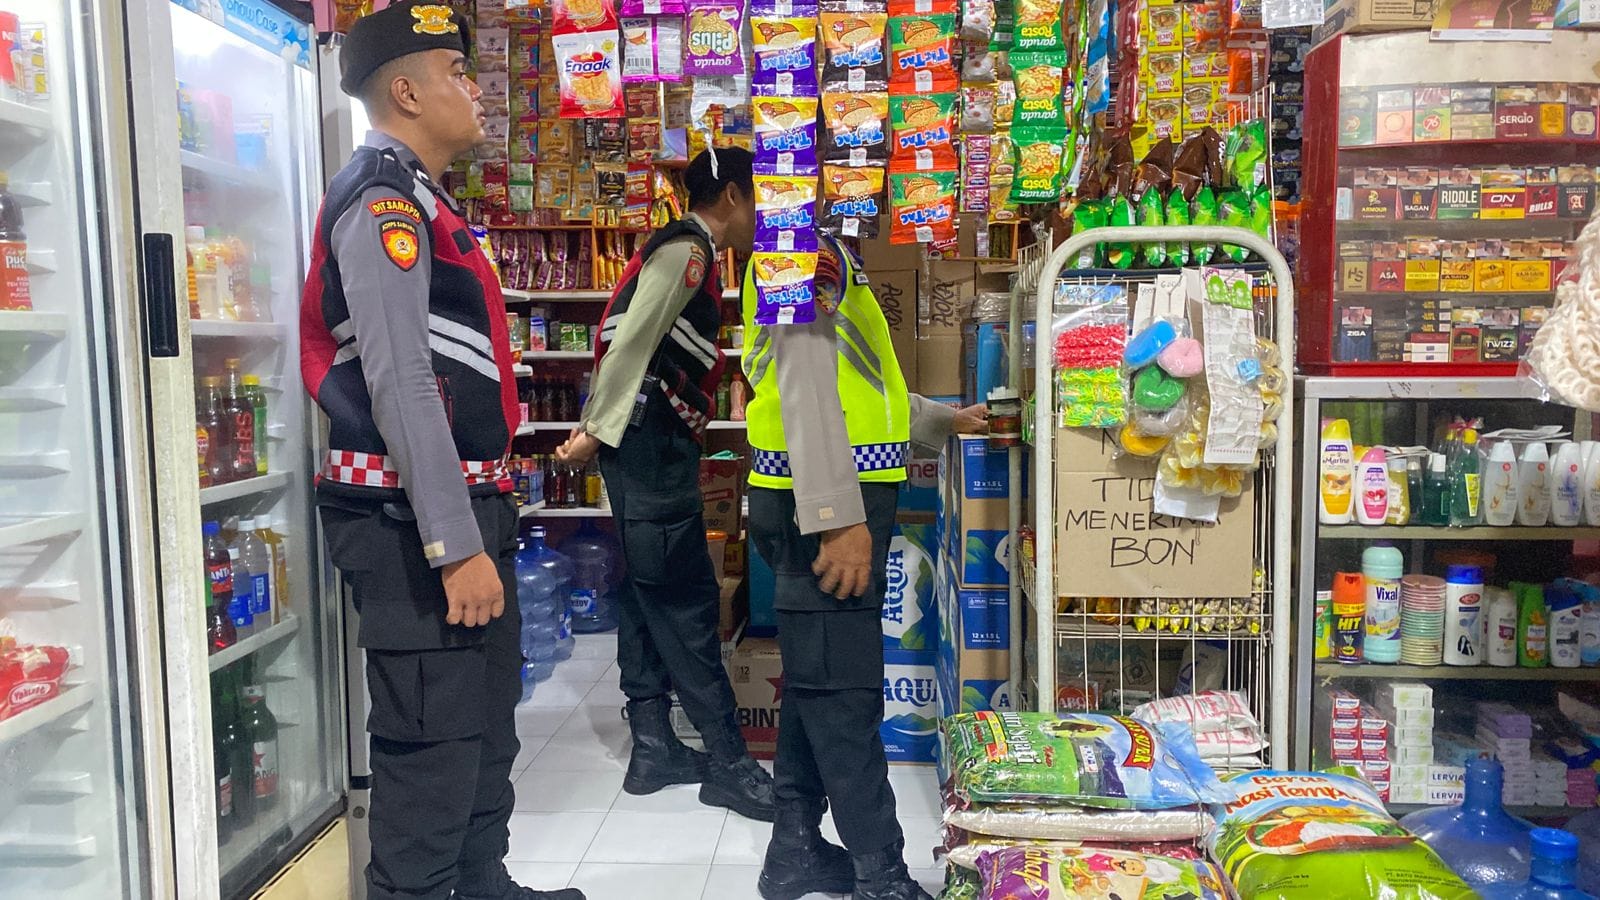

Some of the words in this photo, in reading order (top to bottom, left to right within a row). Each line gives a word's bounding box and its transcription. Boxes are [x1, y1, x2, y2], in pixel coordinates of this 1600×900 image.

[255, 8, 279, 34] Case
[1021, 25, 1055, 37] Rosta
[691, 31, 733, 53] Pilus
[1020, 36, 1056, 48] garuda
[565, 58, 611, 72] Enaak
[694, 56, 732, 69] garuda
[1022, 99, 1056, 111] Rosta
[1020, 109, 1058, 121] garuda
[1499, 112, 1534, 124] SERGIO
[1423, 115, 1439, 130] 76
[1022, 178, 1054, 190] Rosta
[1019, 188, 1055, 198] garuda
[1441, 190, 1478, 204] RIDDLE
[1490, 194, 1516, 203] ON
[372, 201, 386, 212] DIT
[386, 200, 421, 220] SAMAPTA
[1529, 201, 1554, 213] BULLS
[1379, 271, 1398, 279] ASA
[1485, 340, 1515, 348] TWIZZ
[1092, 476, 1155, 502] TID
[1110, 535, 1196, 569] BON
[881, 549, 908, 624] AQUA
[1375, 586, 1398, 601] Vixal
[1337, 617, 1362, 631] HIT
[1002, 711, 1028, 728] utri
[1251, 774, 1328, 785] Beras
[1432, 773, 1465, 781] LERVIA
[1224, 786, 1272, 815] Nasi
